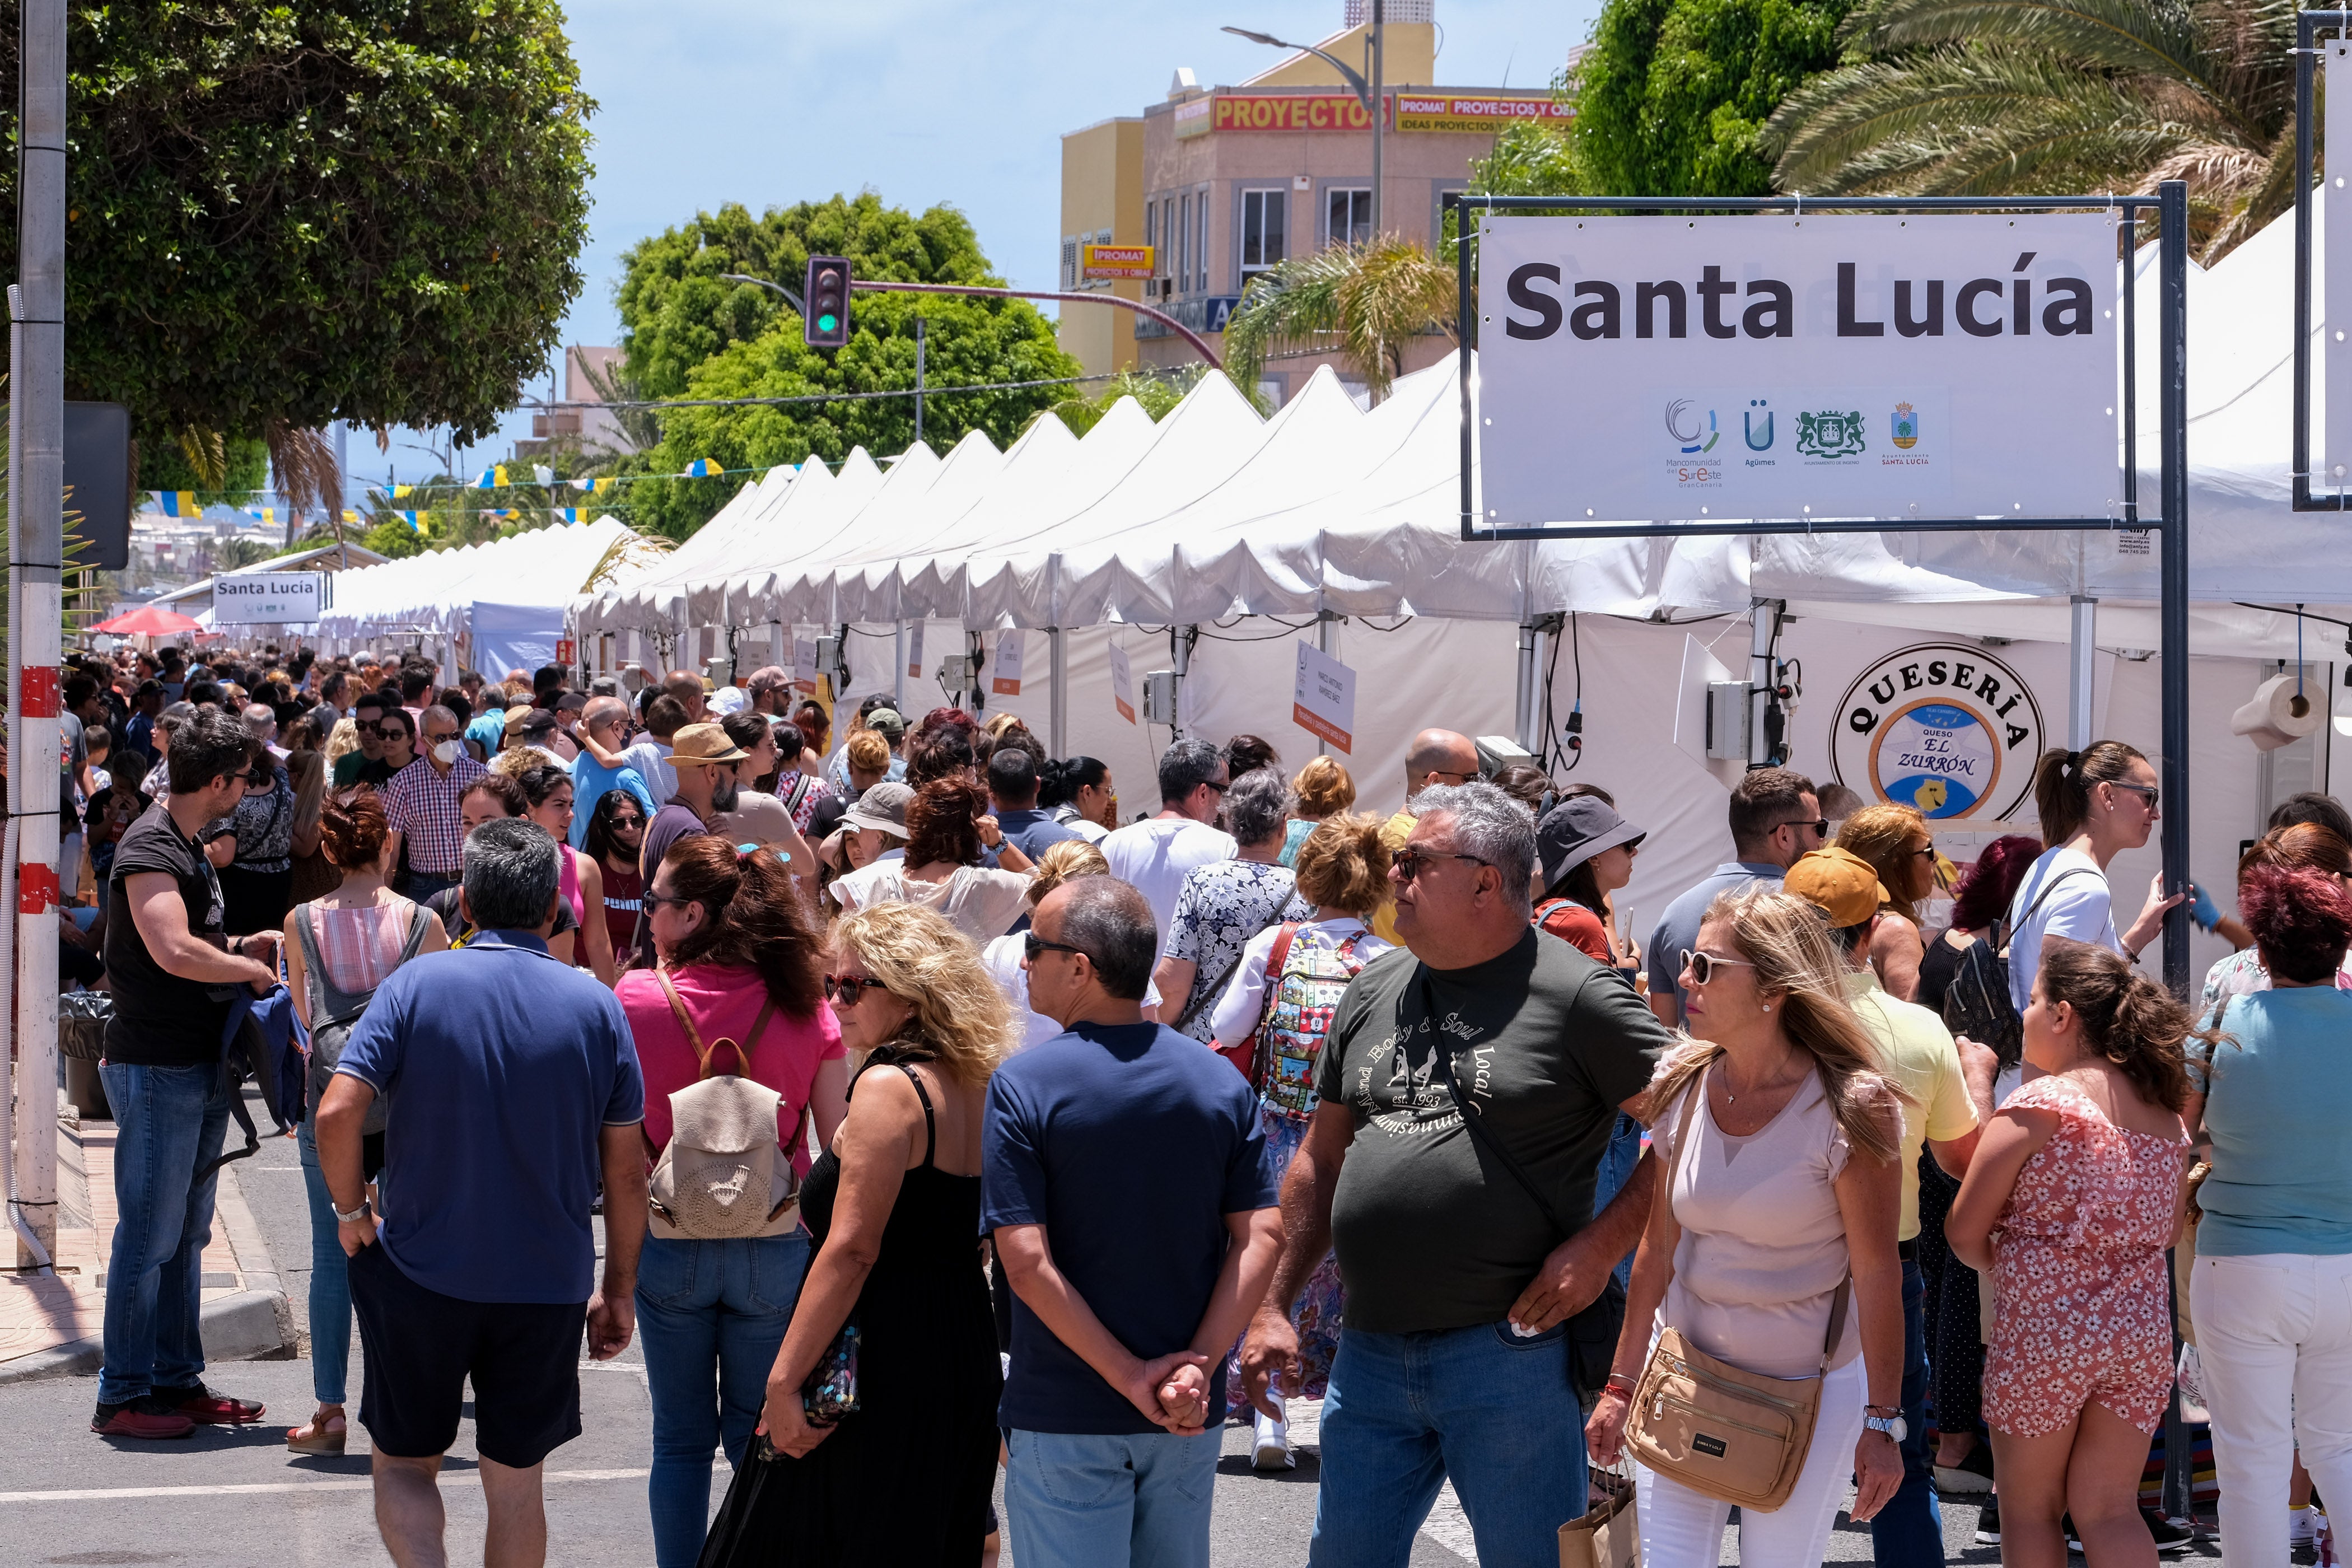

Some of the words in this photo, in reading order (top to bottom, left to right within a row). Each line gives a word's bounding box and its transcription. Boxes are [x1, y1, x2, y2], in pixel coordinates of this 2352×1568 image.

[1400, 99, 1445, 113] IPROMAT
[1454, 100, 1536, 115] PROYECTOS
[1540, 104, 1547, 115] Y
[1401, 120, 1431, 129] IDEAS
[1434, 120, 1494, 131] PROYECTOS
[1094, 248, 1145, 261] IPROMAT
[1506, 262, 1793, 340] Santa
[1837, 251, 2093, 337] Lucía
[218, 582, 264, 595] Santa
[271, 580, 313, 594] Lucía
[1318, 671, 1329, 683] MARCO
[1328, 677, 1343, 691] ANTONIO
[1850, 661, 2029, 750] QUESERÍA
[1923, 729, 1953, 738] QUESO
[1924, 738, 1950, 753] EL
[1897, 753, 1977, 776] ZURRÓN
[1440, 1012, 1484, 1040] Soul
[1367, 1024, 1413, 1064] Body
[1473, 1046, 1496, 1099] Local
[1356, 1066, 1382, 1116] Mind
[1392, 1095, 1408, 1104] est.
[1411, 1094, 1441, 1108] 1993
